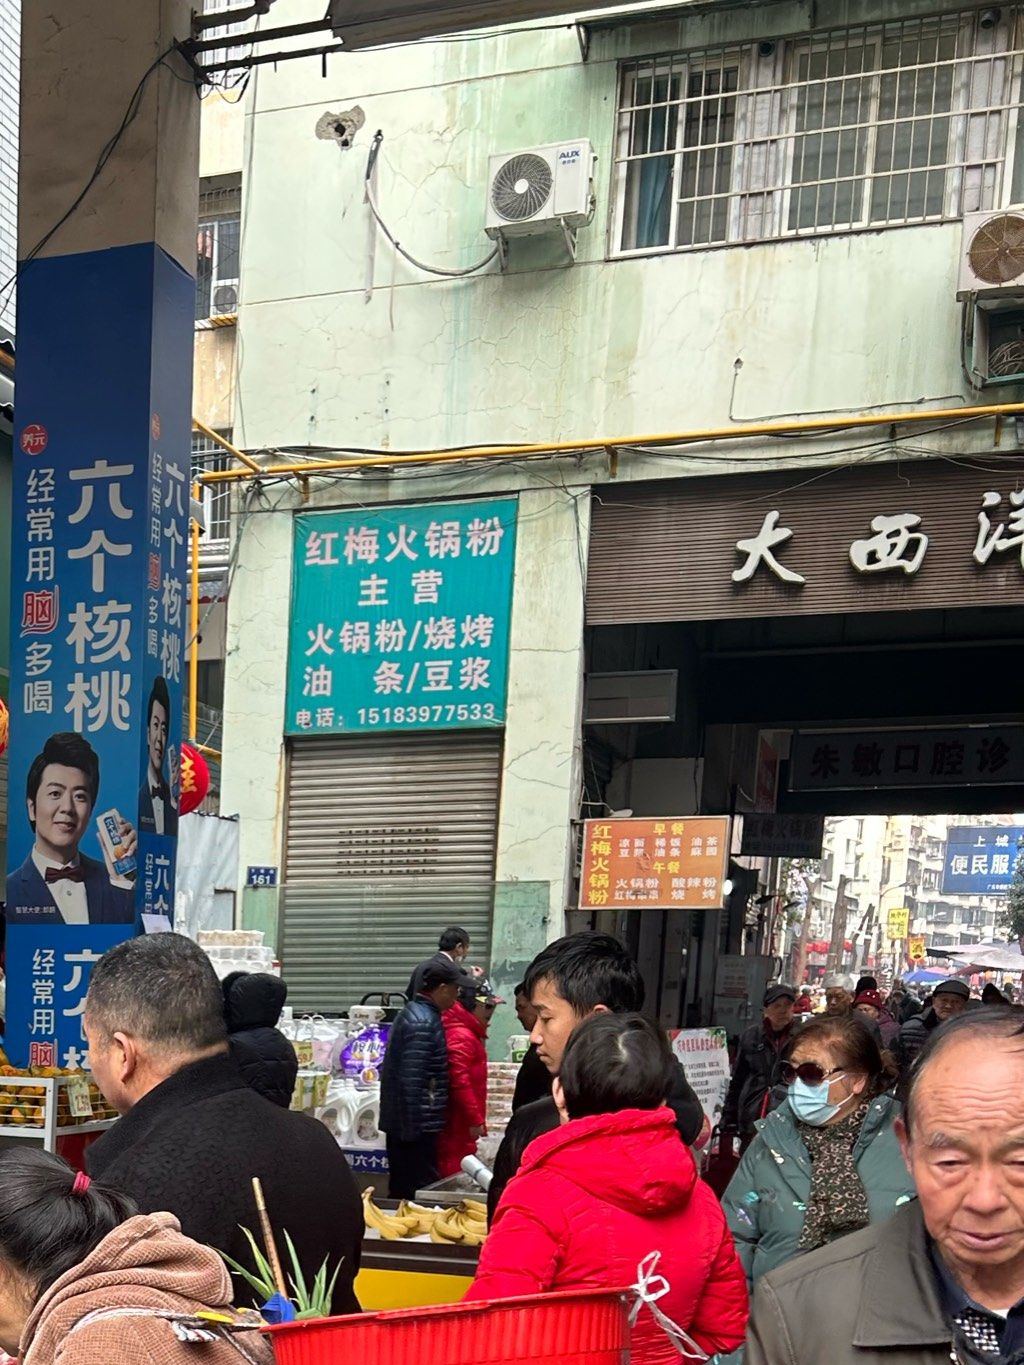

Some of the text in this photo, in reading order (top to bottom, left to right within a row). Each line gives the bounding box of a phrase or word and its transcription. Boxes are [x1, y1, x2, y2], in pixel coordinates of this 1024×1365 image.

[559, 150, 580, 160] AUX
[22, 430, 47, 448] 养元
[304, 516, 505, 567] 红梅火锅粉
[731, 490, 1024, 585] 大西洋
[20, 468, 60, 715] 经常用脑多喝
[159, 461, 186, 684] 六个核桃
[357, 569, 443, 606] 主营
[64, 460, 135, 734] 六个核桃
[305, 613, 495, 656] 火锅粉/烧烤
[358, 703, 495, 725] 15183977533
[809, 737, 1011, 778] 朱敏口腔诊
[653, 822, 685, 836] 早餐
[251, 874, 271, 885] 161
[587, 823, 613, 905] 红梅火锅粉
[616, 877, 718, 889] 火锅粉 酸辣粉
[653, 861, 681, 874] 午餐
